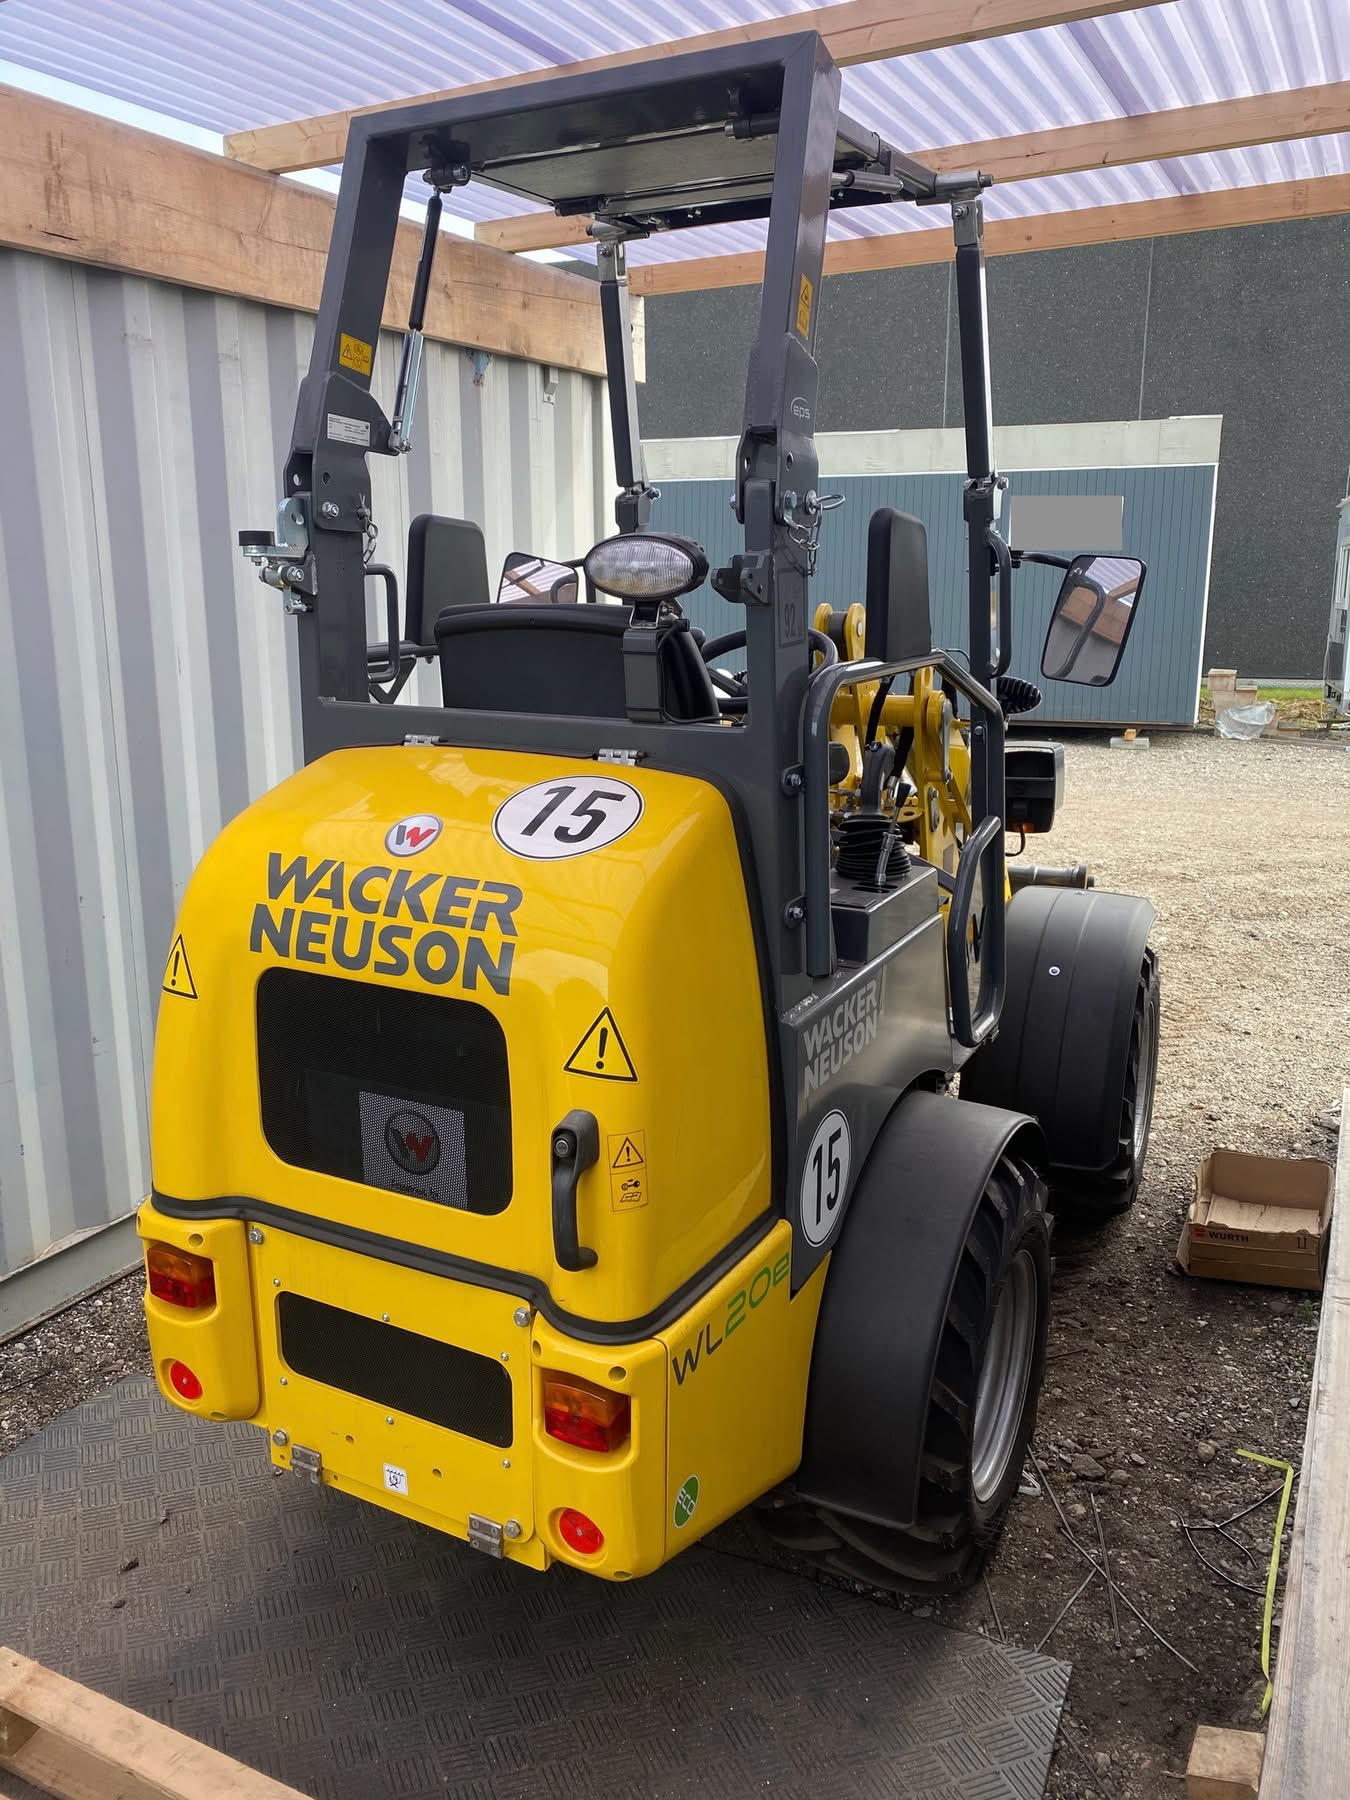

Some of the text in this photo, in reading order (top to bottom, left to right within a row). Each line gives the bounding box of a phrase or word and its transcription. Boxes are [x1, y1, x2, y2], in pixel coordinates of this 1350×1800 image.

[520, 785, 627, 844] 15
[267, 852, 524, 937] WACKER
[249, 903, 516, 997] NEUSON
[803, 980, 877, 1061] WACKER
[804, 1010, 877, 1098] NEUSON
[812, 1126, 842, 1227] 15
[677, 1487, 696, 1516] ECO
